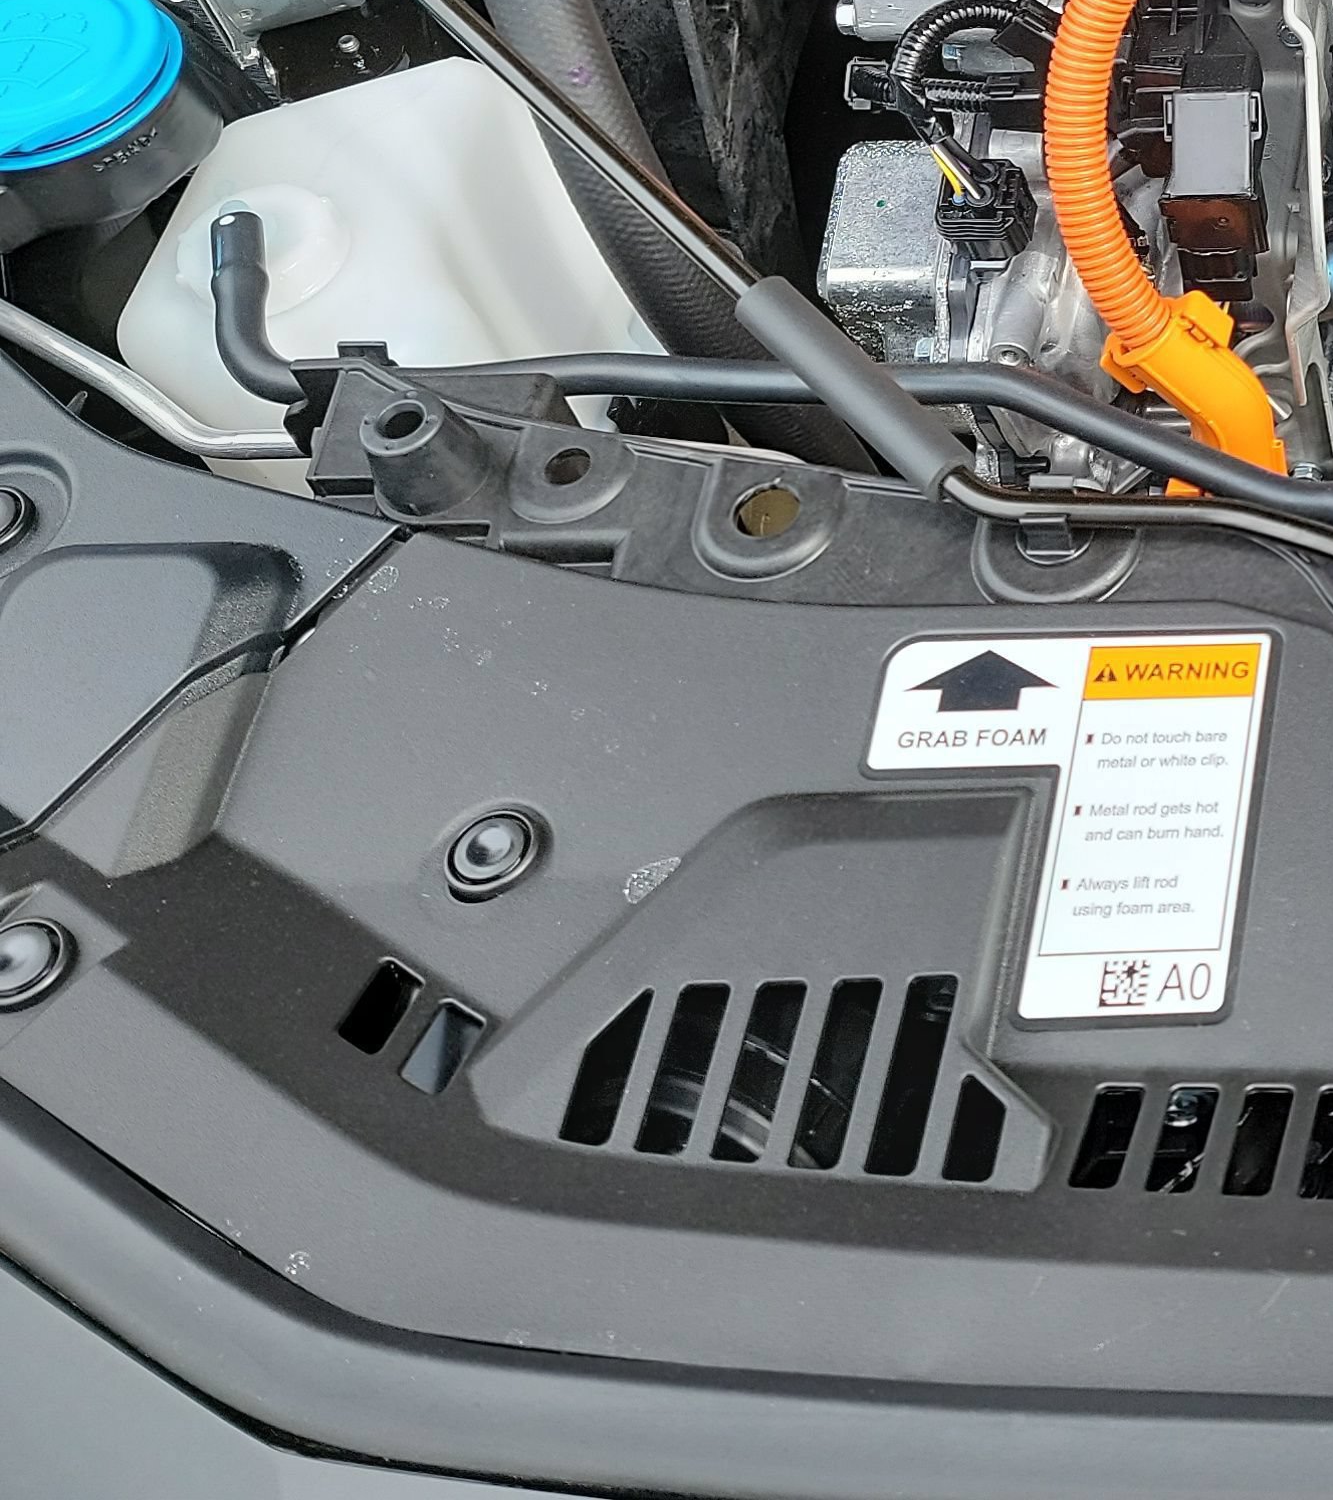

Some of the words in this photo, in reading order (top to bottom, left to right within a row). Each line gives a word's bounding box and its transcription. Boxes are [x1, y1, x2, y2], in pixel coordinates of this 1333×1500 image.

[1125, 660, 1250, 683] WARNING
[897, 729, 968, 749] GRAB
[975, 727, 1047, 748] FOAM
[1101, 732, 1122, 745] Do
[1125, 733, 1149, 745] not
[1152, 731, 1191, 744] touch
[1195, 731, 1228, 743] bare
[1097, 754, 1136, 769] metal
[1140, 757, 1155, 768] or
[1158, 754, 1196, 767] white
[1200, 753, 1229, 769] clip.
[1089, 803, 1129, 817] Metal
[1132, 803, 1157, 816] rod
[1160, 803, 1191, 818] gets
[1195, 801, 1219, 814] hot
[1085, 829, 1113, 841] and
[1116, 830, 1143, 841] can
[1147, 827, 1180, 840] burn
[1184, 825, 1224, 839] hand.
[1076, 878, 1129, 893] Always
[1132, 876, 1150, 890] lift
[1154, 876, 1179, 889] rod
[1072, 904, 1112, 918] using
[1116, 902, 1153, 915] foam
[1157, 902, 1195, 914] area.
[1155, 962, 1212, 1002] A0
